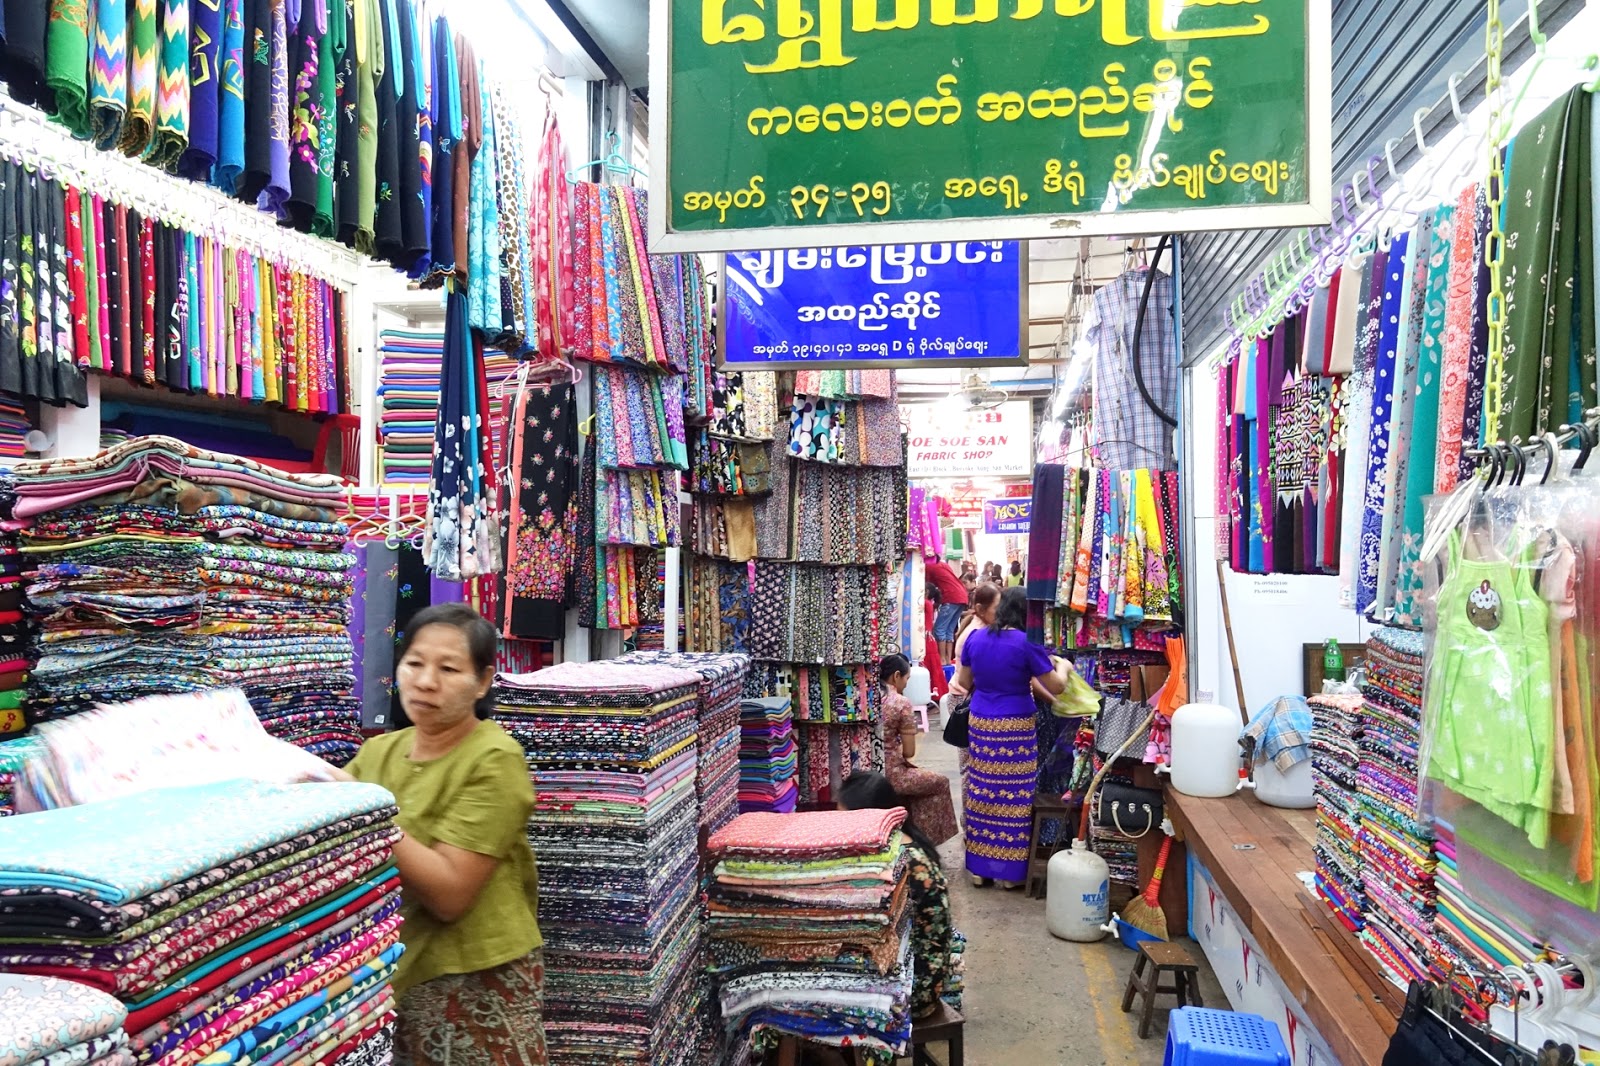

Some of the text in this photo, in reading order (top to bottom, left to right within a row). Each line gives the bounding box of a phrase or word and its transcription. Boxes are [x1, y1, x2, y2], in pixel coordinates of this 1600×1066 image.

[746, 57, 1214, 138] ကလေးဝတ် အထည်ဆိုင်
[683, 175, 766, 223] အမှတ်
[797, 290, 941, 331] အထည်ဆိုင်
[753, 340, 789, 359] အမှတ်
[916, 450, 993, 461] FABRIC SHOP
[940, 437, 971, 447] SOE
[976, 435, 1008, 446] SAN
